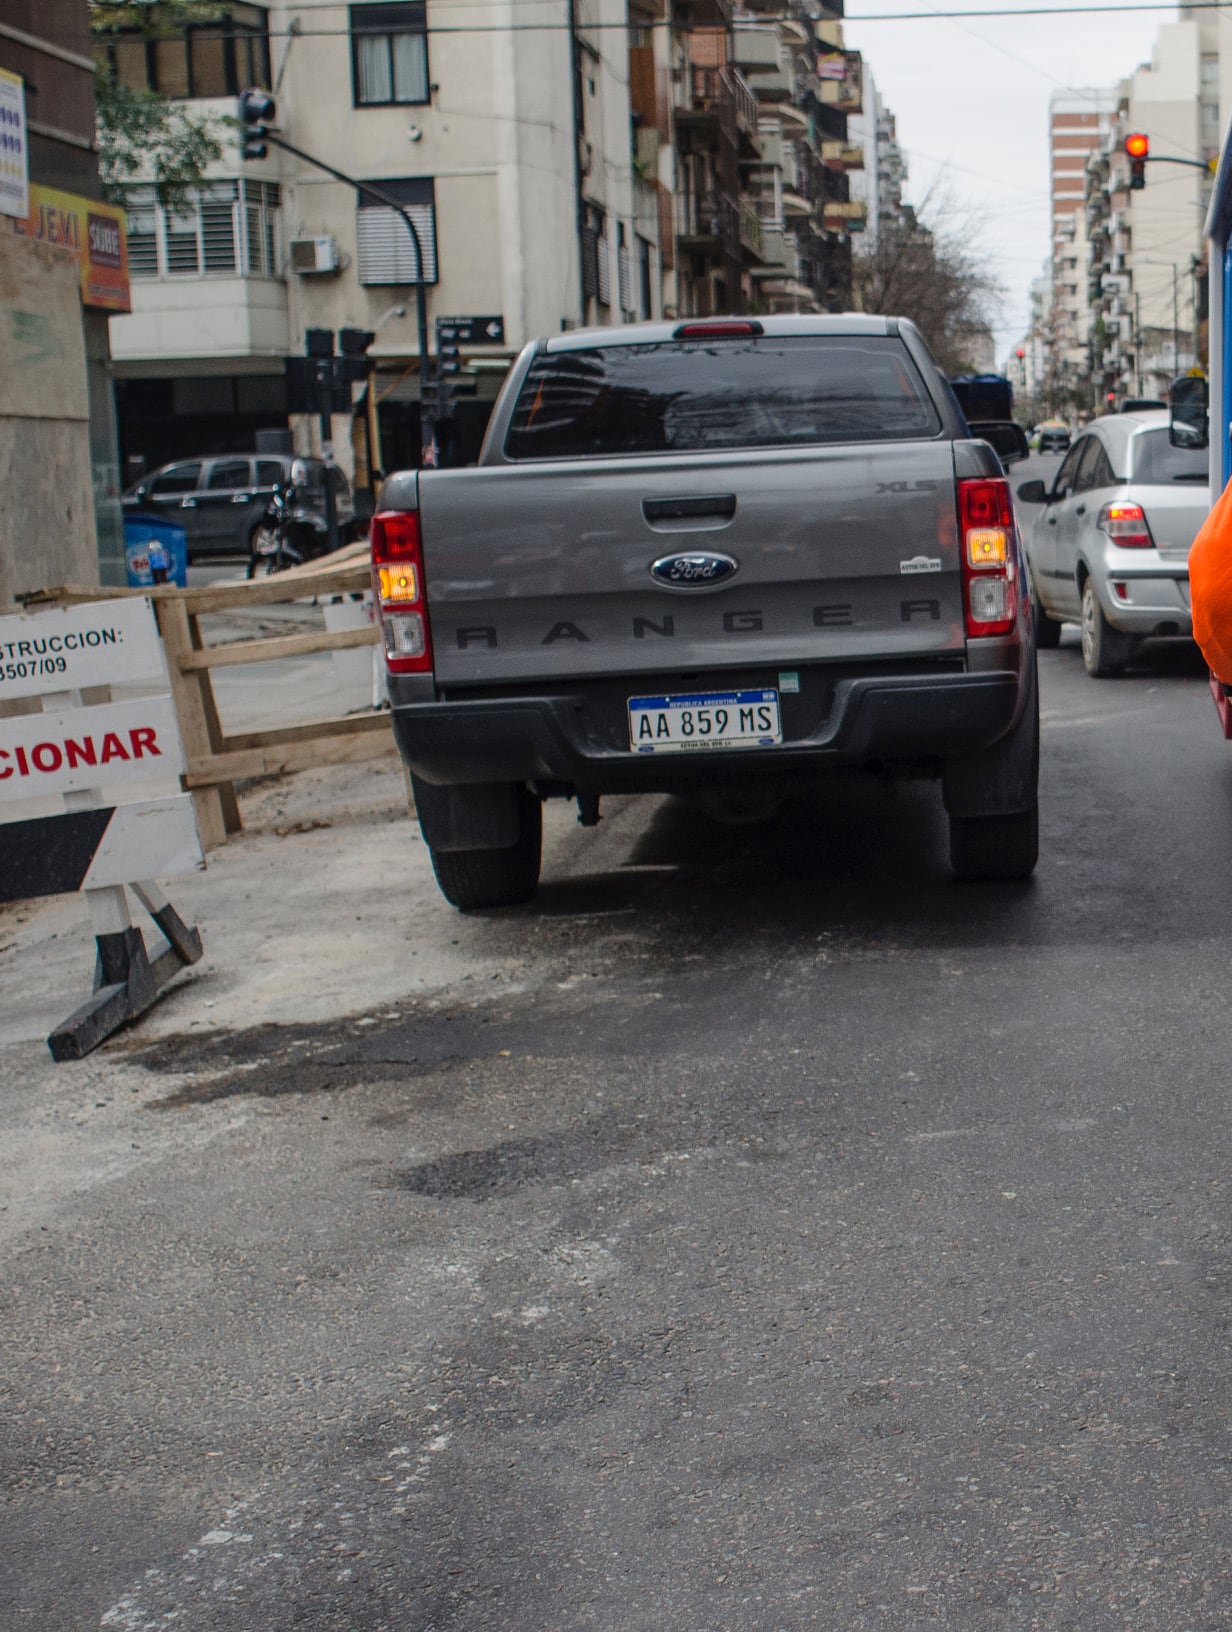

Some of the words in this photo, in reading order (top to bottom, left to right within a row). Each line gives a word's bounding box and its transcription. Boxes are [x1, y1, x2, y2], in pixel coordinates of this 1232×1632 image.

[89, 223, 119, 256] SUBE
[875, 480, 937, 494] XLS
[670, 560, 718, 579] Ford
[456, 599, 941, 650] RANGER
[0, 627, 124, 661] TRUCCION:
[703, 698, 737, 706] ARGENTINA
[639, 713, 671, 740] AA
[681, 709, 729, 736] 859
[739, 706, 772, 733] MS
